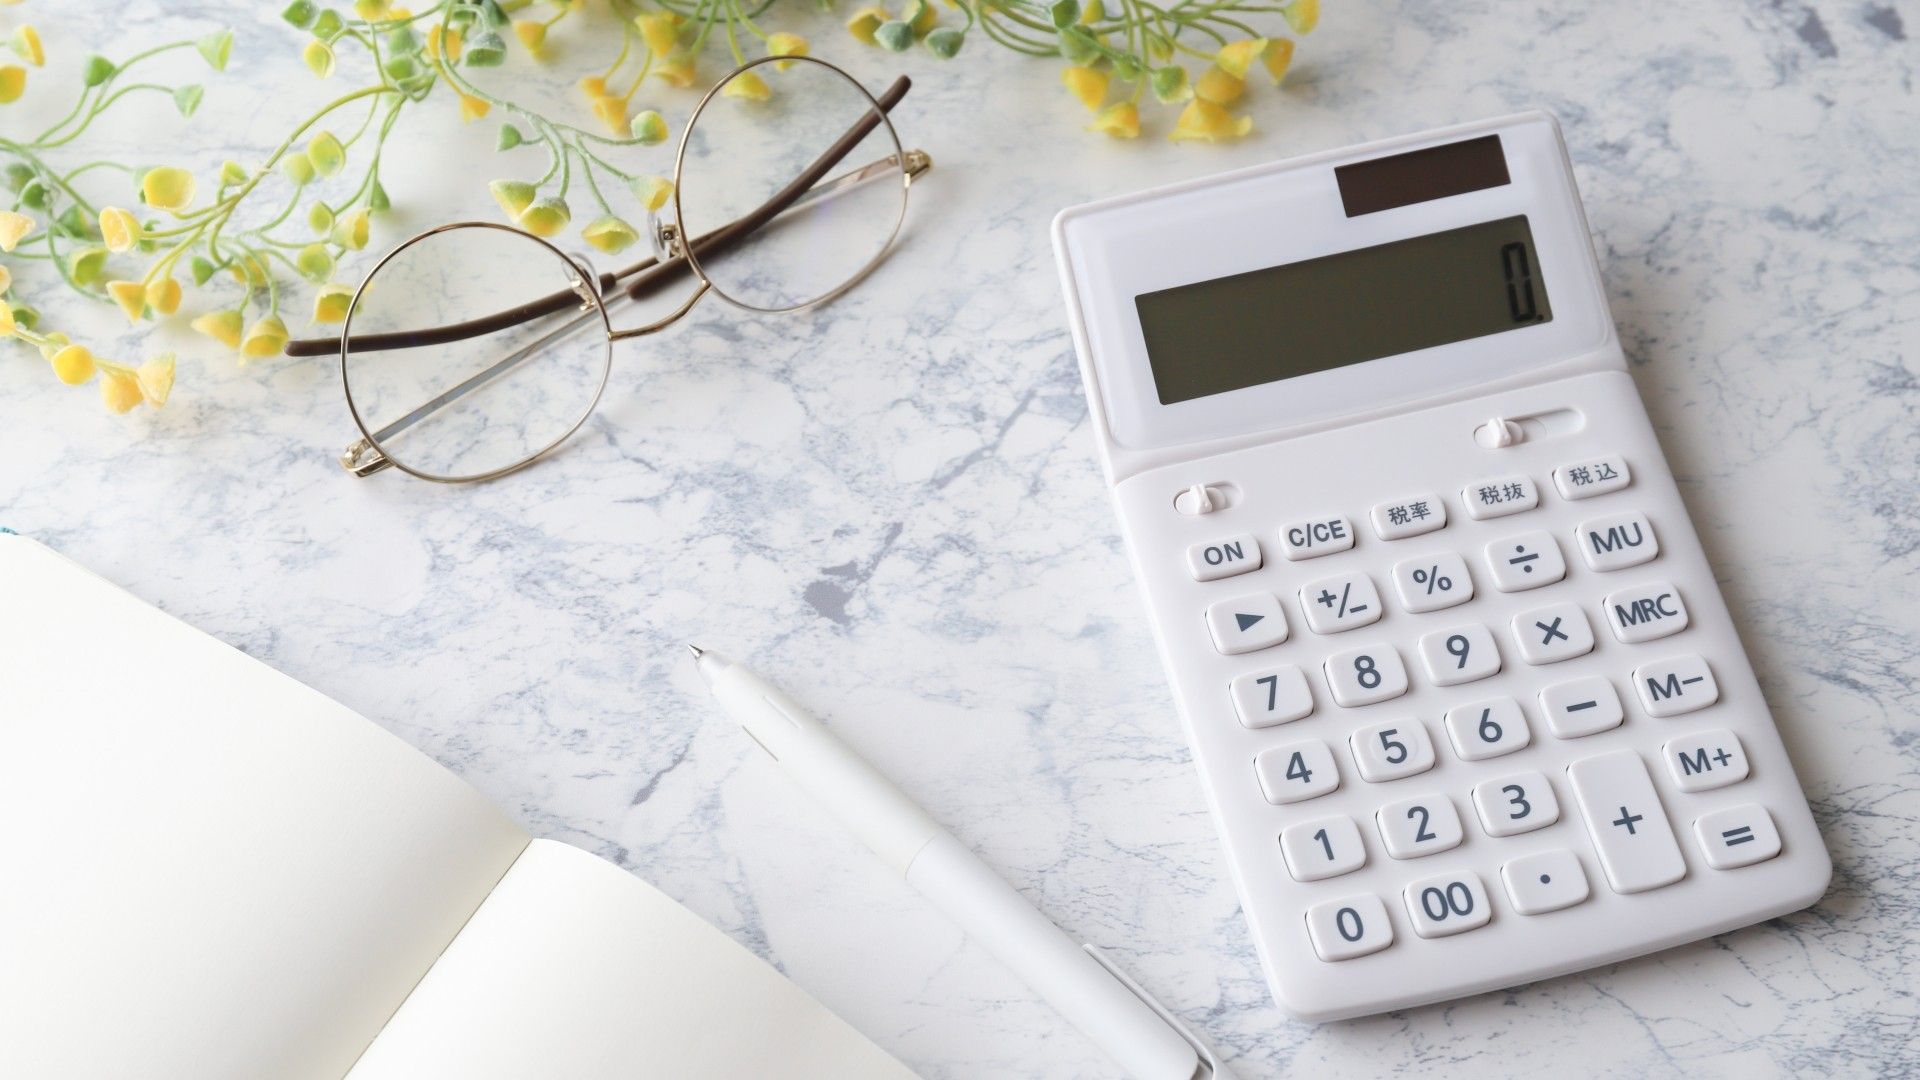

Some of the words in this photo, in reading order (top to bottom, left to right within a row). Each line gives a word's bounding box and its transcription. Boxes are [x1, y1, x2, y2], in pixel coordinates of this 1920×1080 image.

[1569, 462, 1619, 487] 税込
[1478, 482, 1526, 506] 税抜
[1388, 501, 1431, 526] 税率
[1288, 519, 1346, 548] C/CE
[1589, 521, 1644, 555] MU
[1203, 541, 1244, 566] ON
[1412, 565, 1453, 596] %
[1615, 592, 1678, 628] MRC
[1446, 635, 1471, 670] 9
[1354, 656, 1382, 690] 8
[1256, 675, 1278, 712] 7
[1479, 707, 1503, 744] 6
[1379, 729, 1408, 765] 5
[1679, 748, 1732, 777] M+
[1286, 752, 1312, 784] 4
[1502, 784, 1531, 821] 3
[1408, 806, 1437, 843] 2
[1314, 829, 1335, 861] 1
[1422, 882, 1474, 922] 00
[1336, 908, 1364, 943] 0
